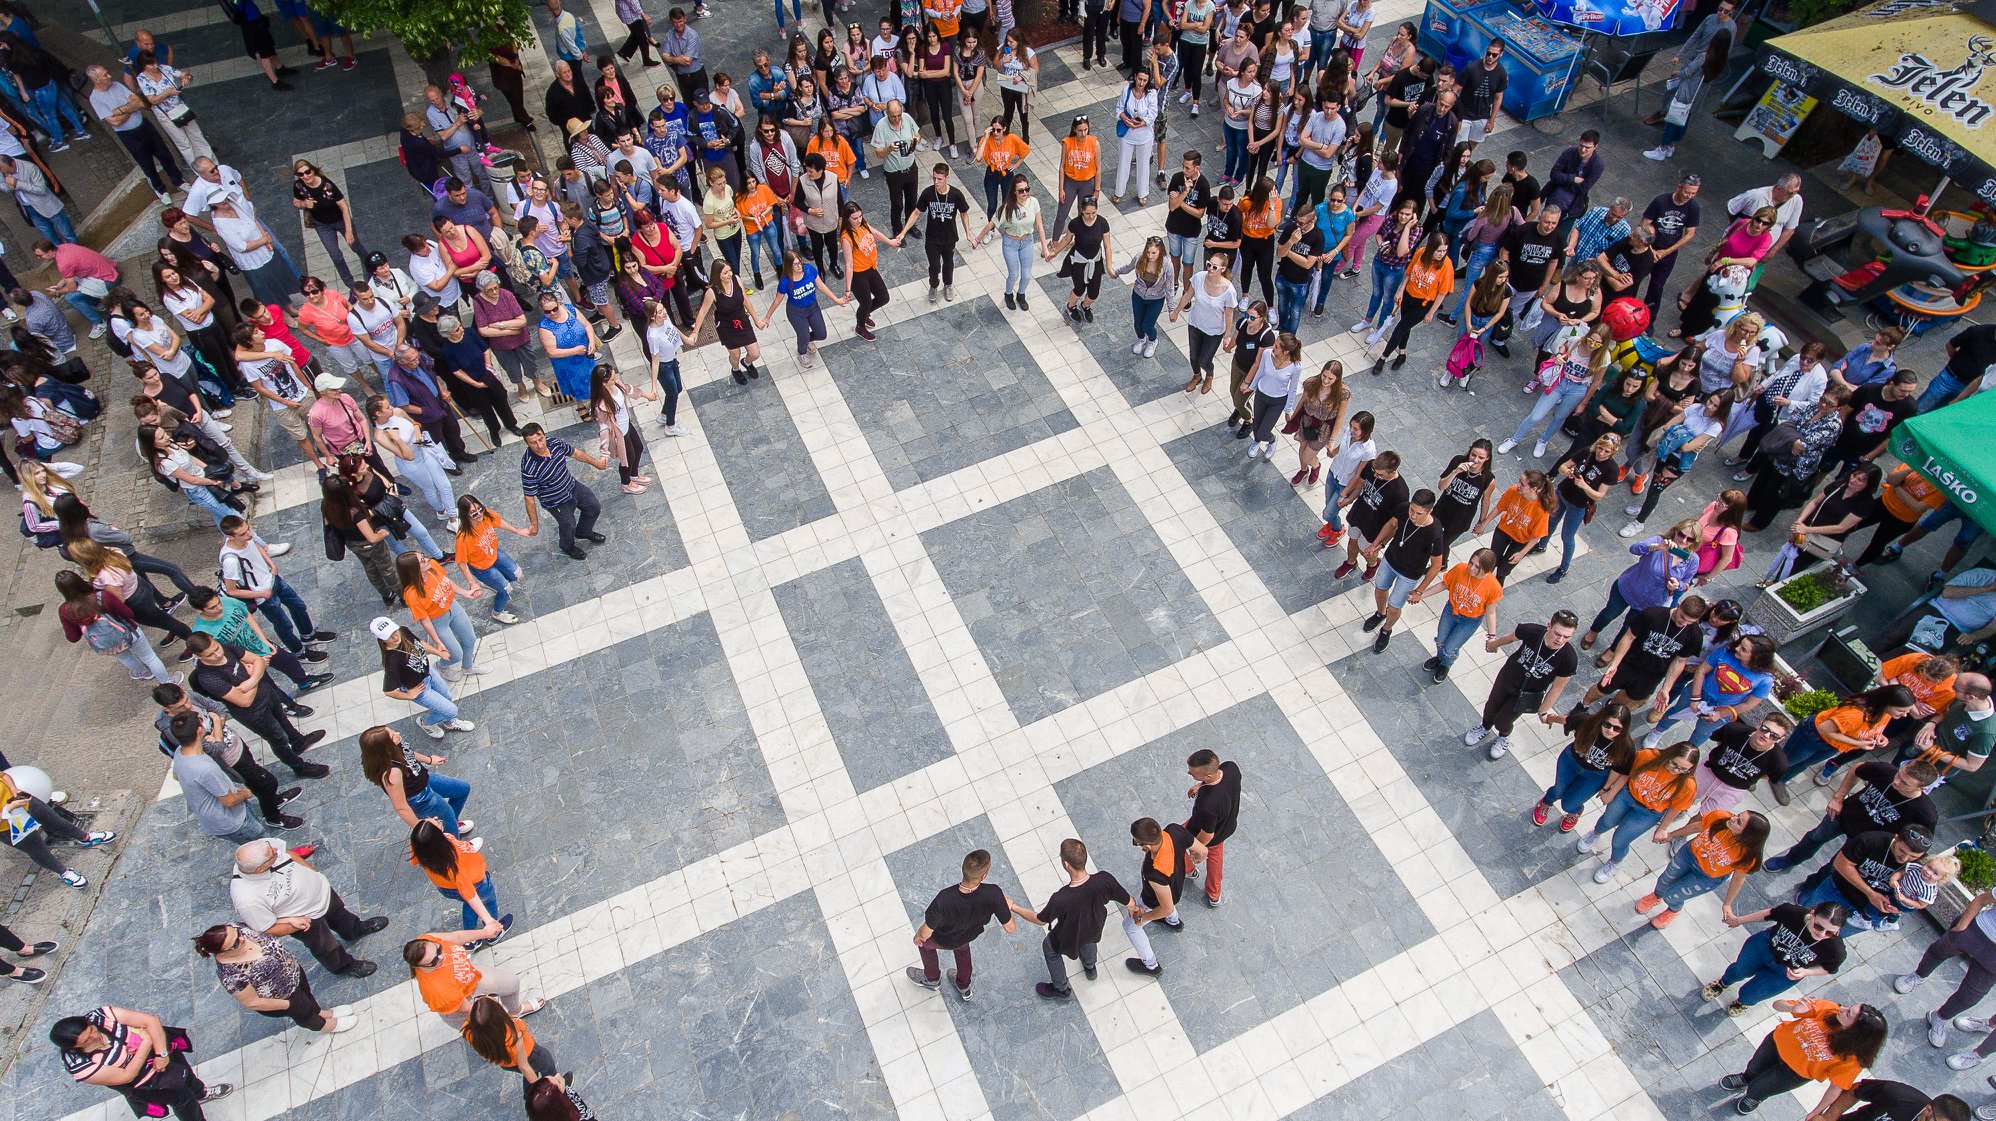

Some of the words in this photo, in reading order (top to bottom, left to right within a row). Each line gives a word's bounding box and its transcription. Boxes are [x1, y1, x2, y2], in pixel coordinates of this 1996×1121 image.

[1765, 55, 1798, 81] Jelen
[1832, 89, 1870, 117] Jelen
[1866, 53, 1993, 129] Jelen
[1902, 95, 1933, 115] PIVO
[1902, 128, 1941, 161] Jelen
[1921, 455, 1978, 504] LAŠKO
[217, 624, 235, 642] THE
